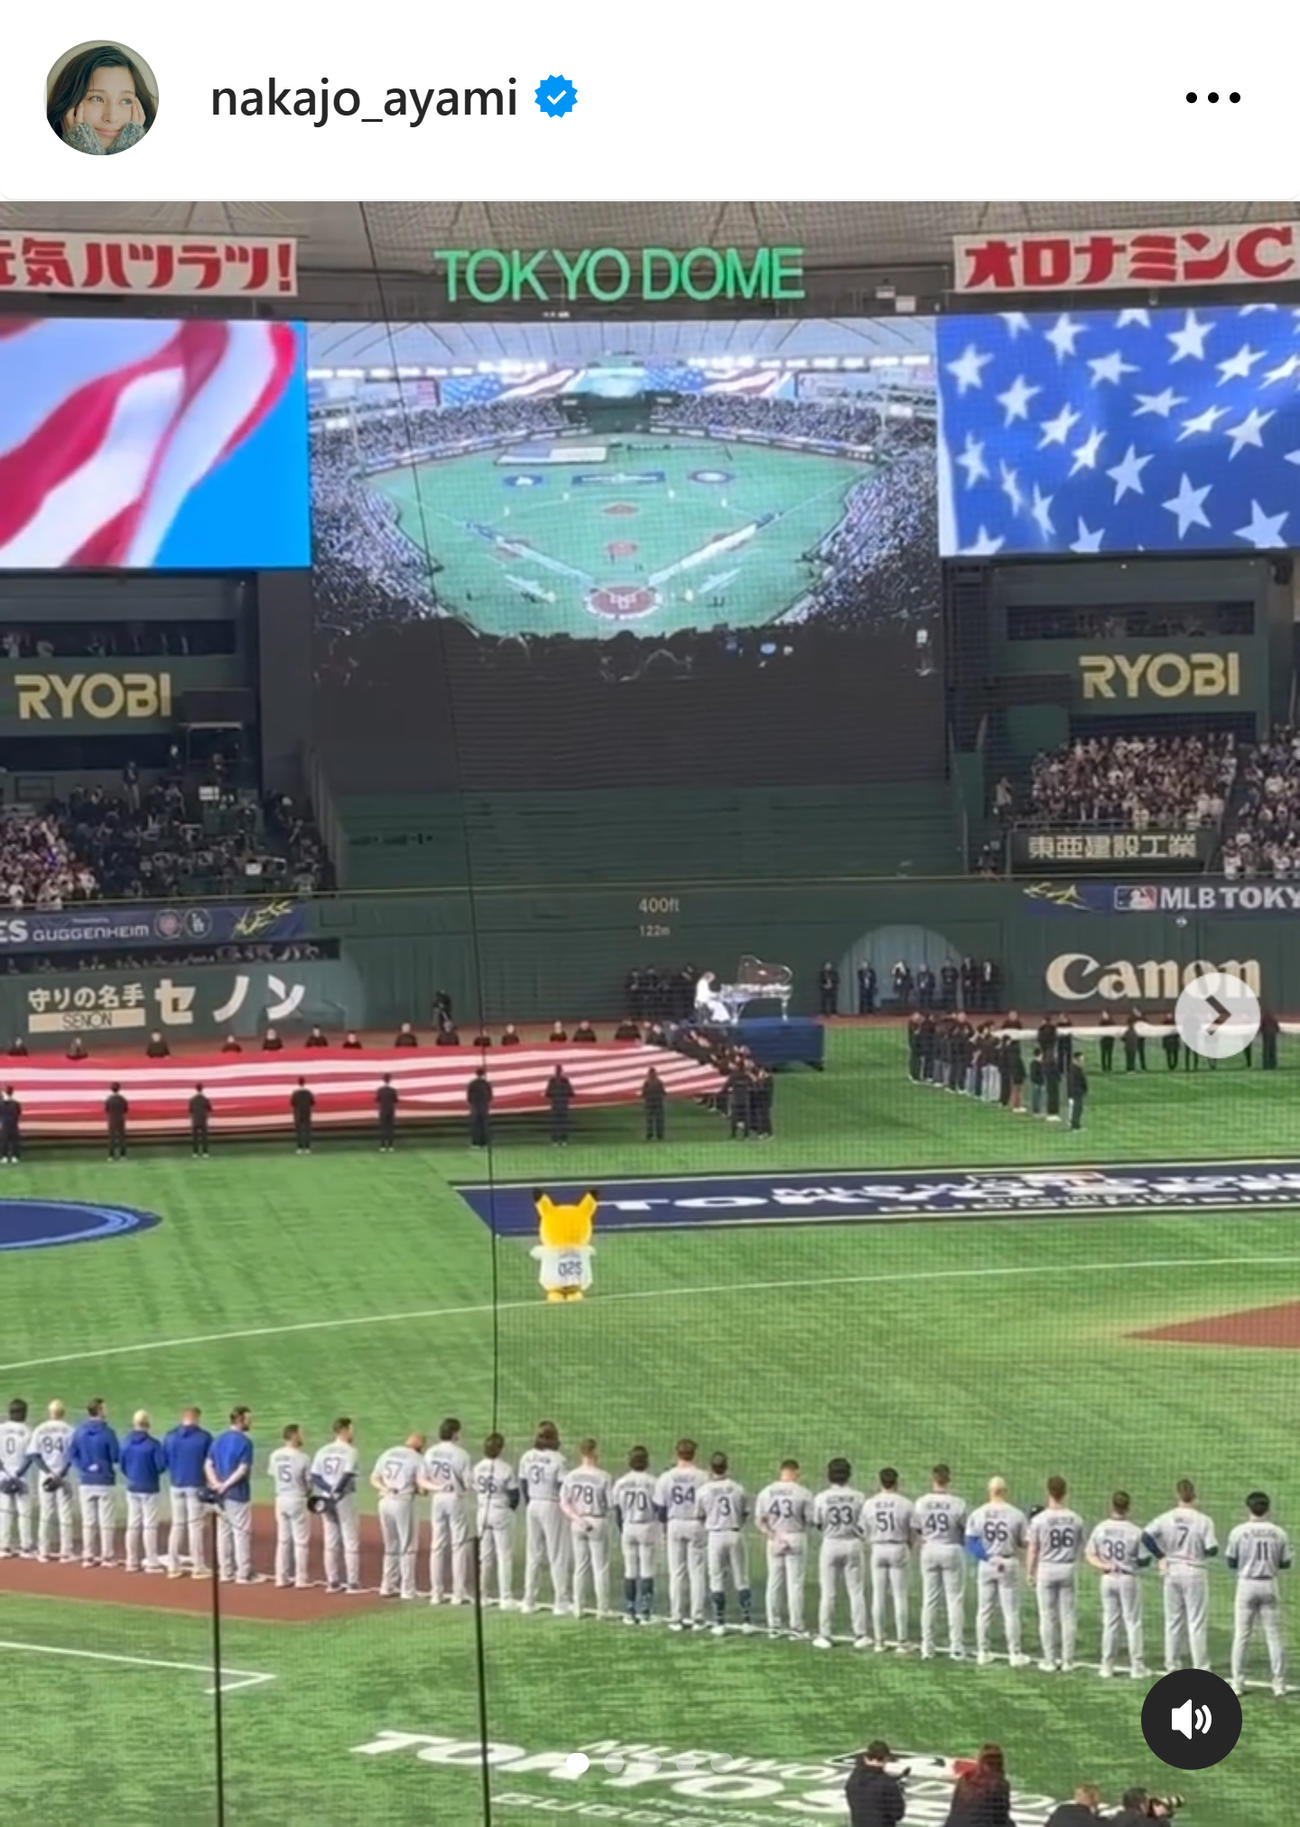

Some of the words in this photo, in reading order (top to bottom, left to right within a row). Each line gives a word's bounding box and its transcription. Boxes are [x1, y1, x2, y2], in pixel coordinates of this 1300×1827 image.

[965, 227, 1295, 288] オロナミンC
[435, 249, 630, 302] TOKYO
[642, 247, 805, 300] DOME
[1079, 652, 1240, 698] RYOBI
[14, 673, 172, 719] RYOBI
[1028, 834, 1197, 859] 東亜建設工業
[639, 897, 680, 913] 400ft
[1160, 887, 1216, 909] MLB
[1219, 885, 1300, 910] TOKY
[1046, 953, 1260, 1000] Canon
[28, 983, 145, 1012] 守りの名手
[154, 975, 305, 1024] セノン
[41, 1437, 64, 1454] 84
[573, 1484, 593, 1505] 78
[671, 1485, 696, 1505] 64
[719, 1497, 731, 1517] 3
[769, 1499, 793, 1519] 43
[829, 1505, 853, 1526] 33
[876, 1510, 896, 1533] 51
[925, 1512, 950, 1533] 49
[1050, 1527, 1075, 1550] 86
[1177, 1526, 1190, 1548] 7
[1102, 1539, 1126, 1561] 38
[1257, 1541, 1269, 1562] 11
